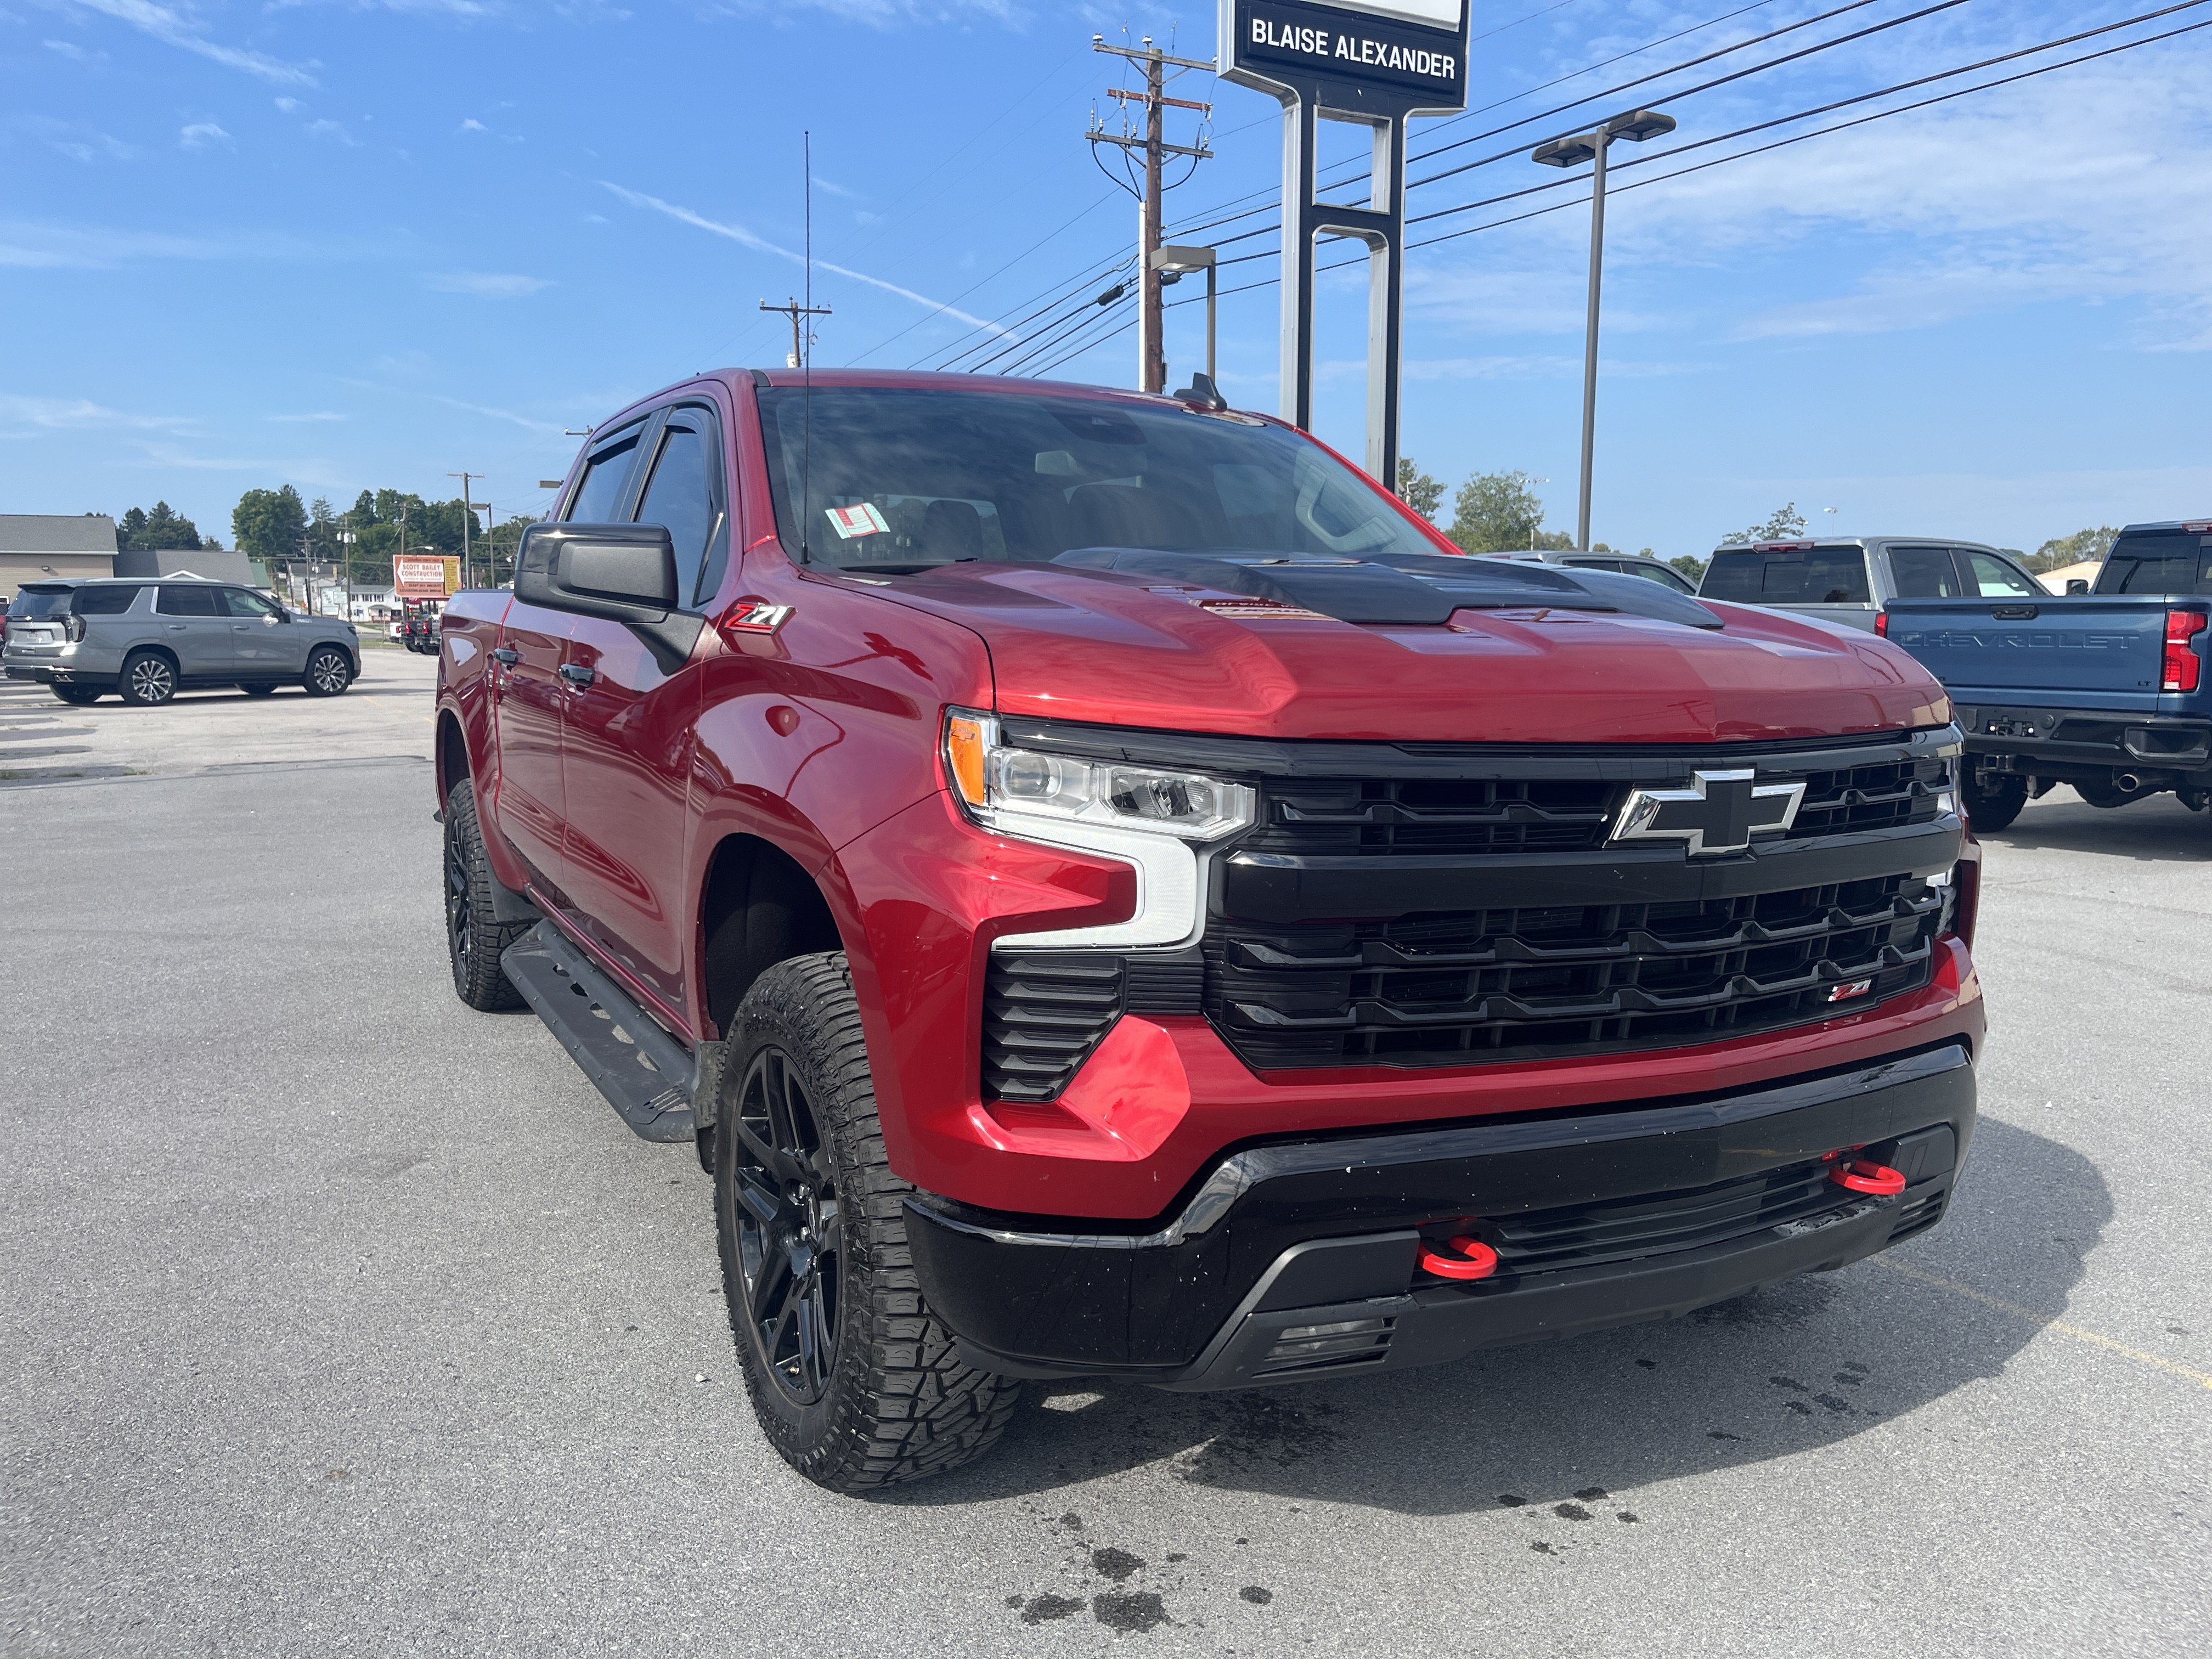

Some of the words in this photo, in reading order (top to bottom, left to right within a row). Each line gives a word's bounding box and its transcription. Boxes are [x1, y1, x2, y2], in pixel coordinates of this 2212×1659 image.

[1252, 18, 1328, 55] BLAISE
[1335, 35, 1455, 80] ALEXANDER
[724, 601, 798, 635] Z71
[1900, 632, 2140, 649] CHEVROLET
[1828, 979, 1872, 1002] Z71
